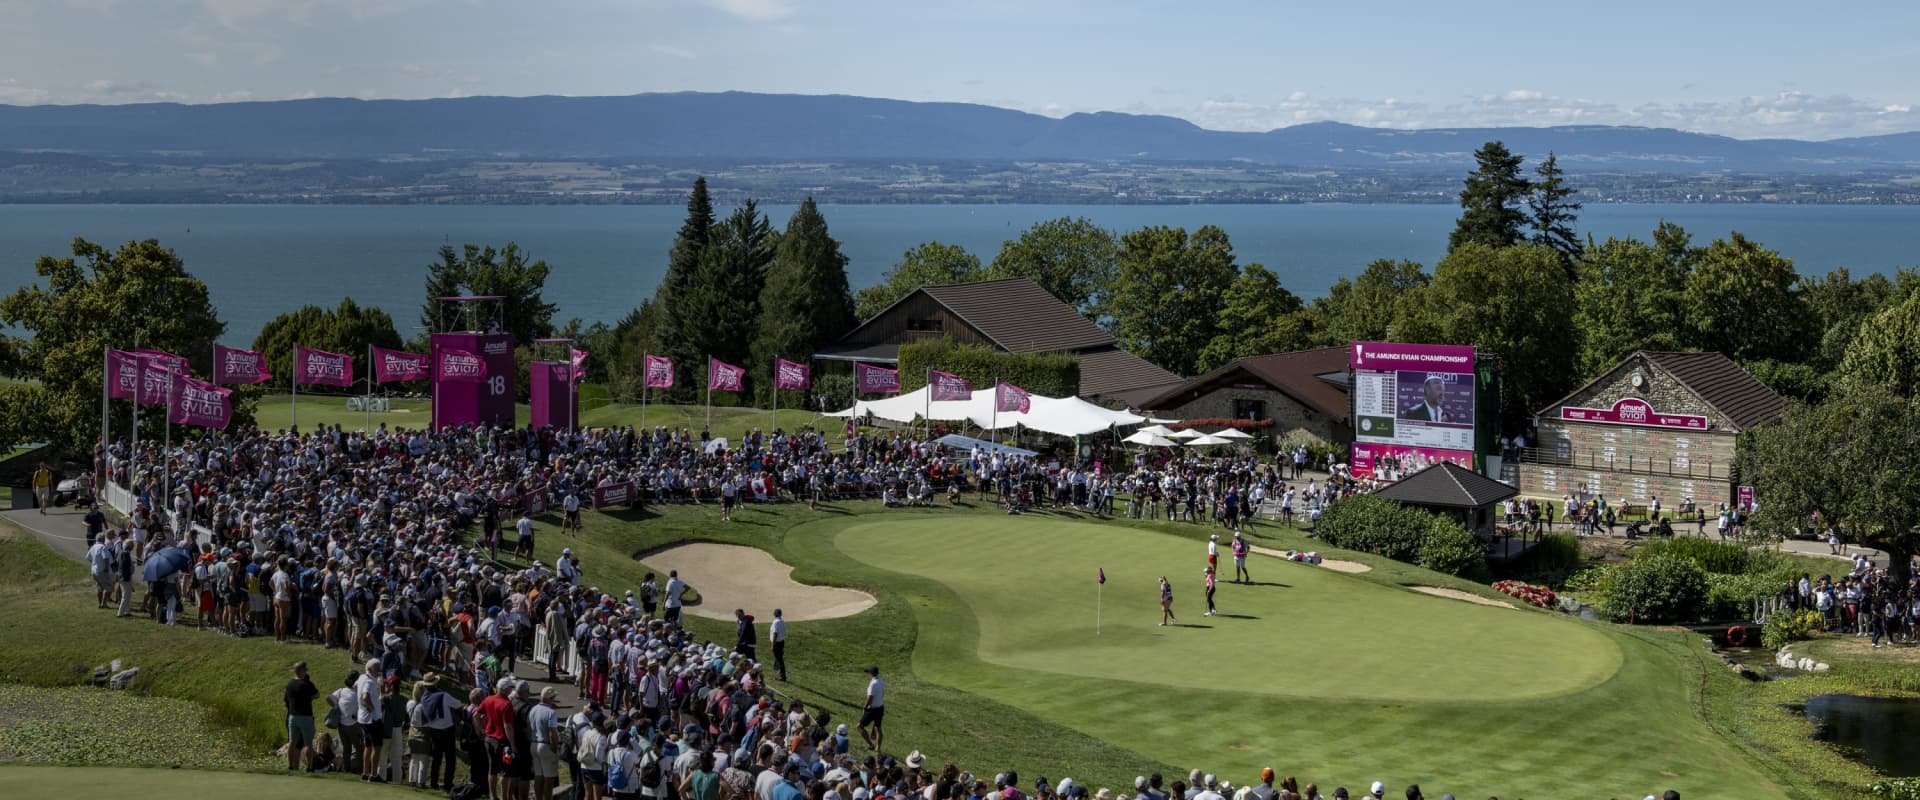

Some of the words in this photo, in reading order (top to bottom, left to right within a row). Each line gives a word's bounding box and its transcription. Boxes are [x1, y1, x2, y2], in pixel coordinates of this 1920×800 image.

[225, 352, 258, 362] Amundi
[307, 353, 344, 366] Amundi
[1421, 354, 1468, 363] CHAMPIONSHIP
[307, 364, 345, 379] evian
[445, 364, 480, 374] evian
[487, 375, 506, 396] 18
[181, 400, 223, 417] evian
[1619, 404, 1647, 412] Amundi
[1619, 411, 1647, 420] evian
[603, 486, 628, 498] Amundi
